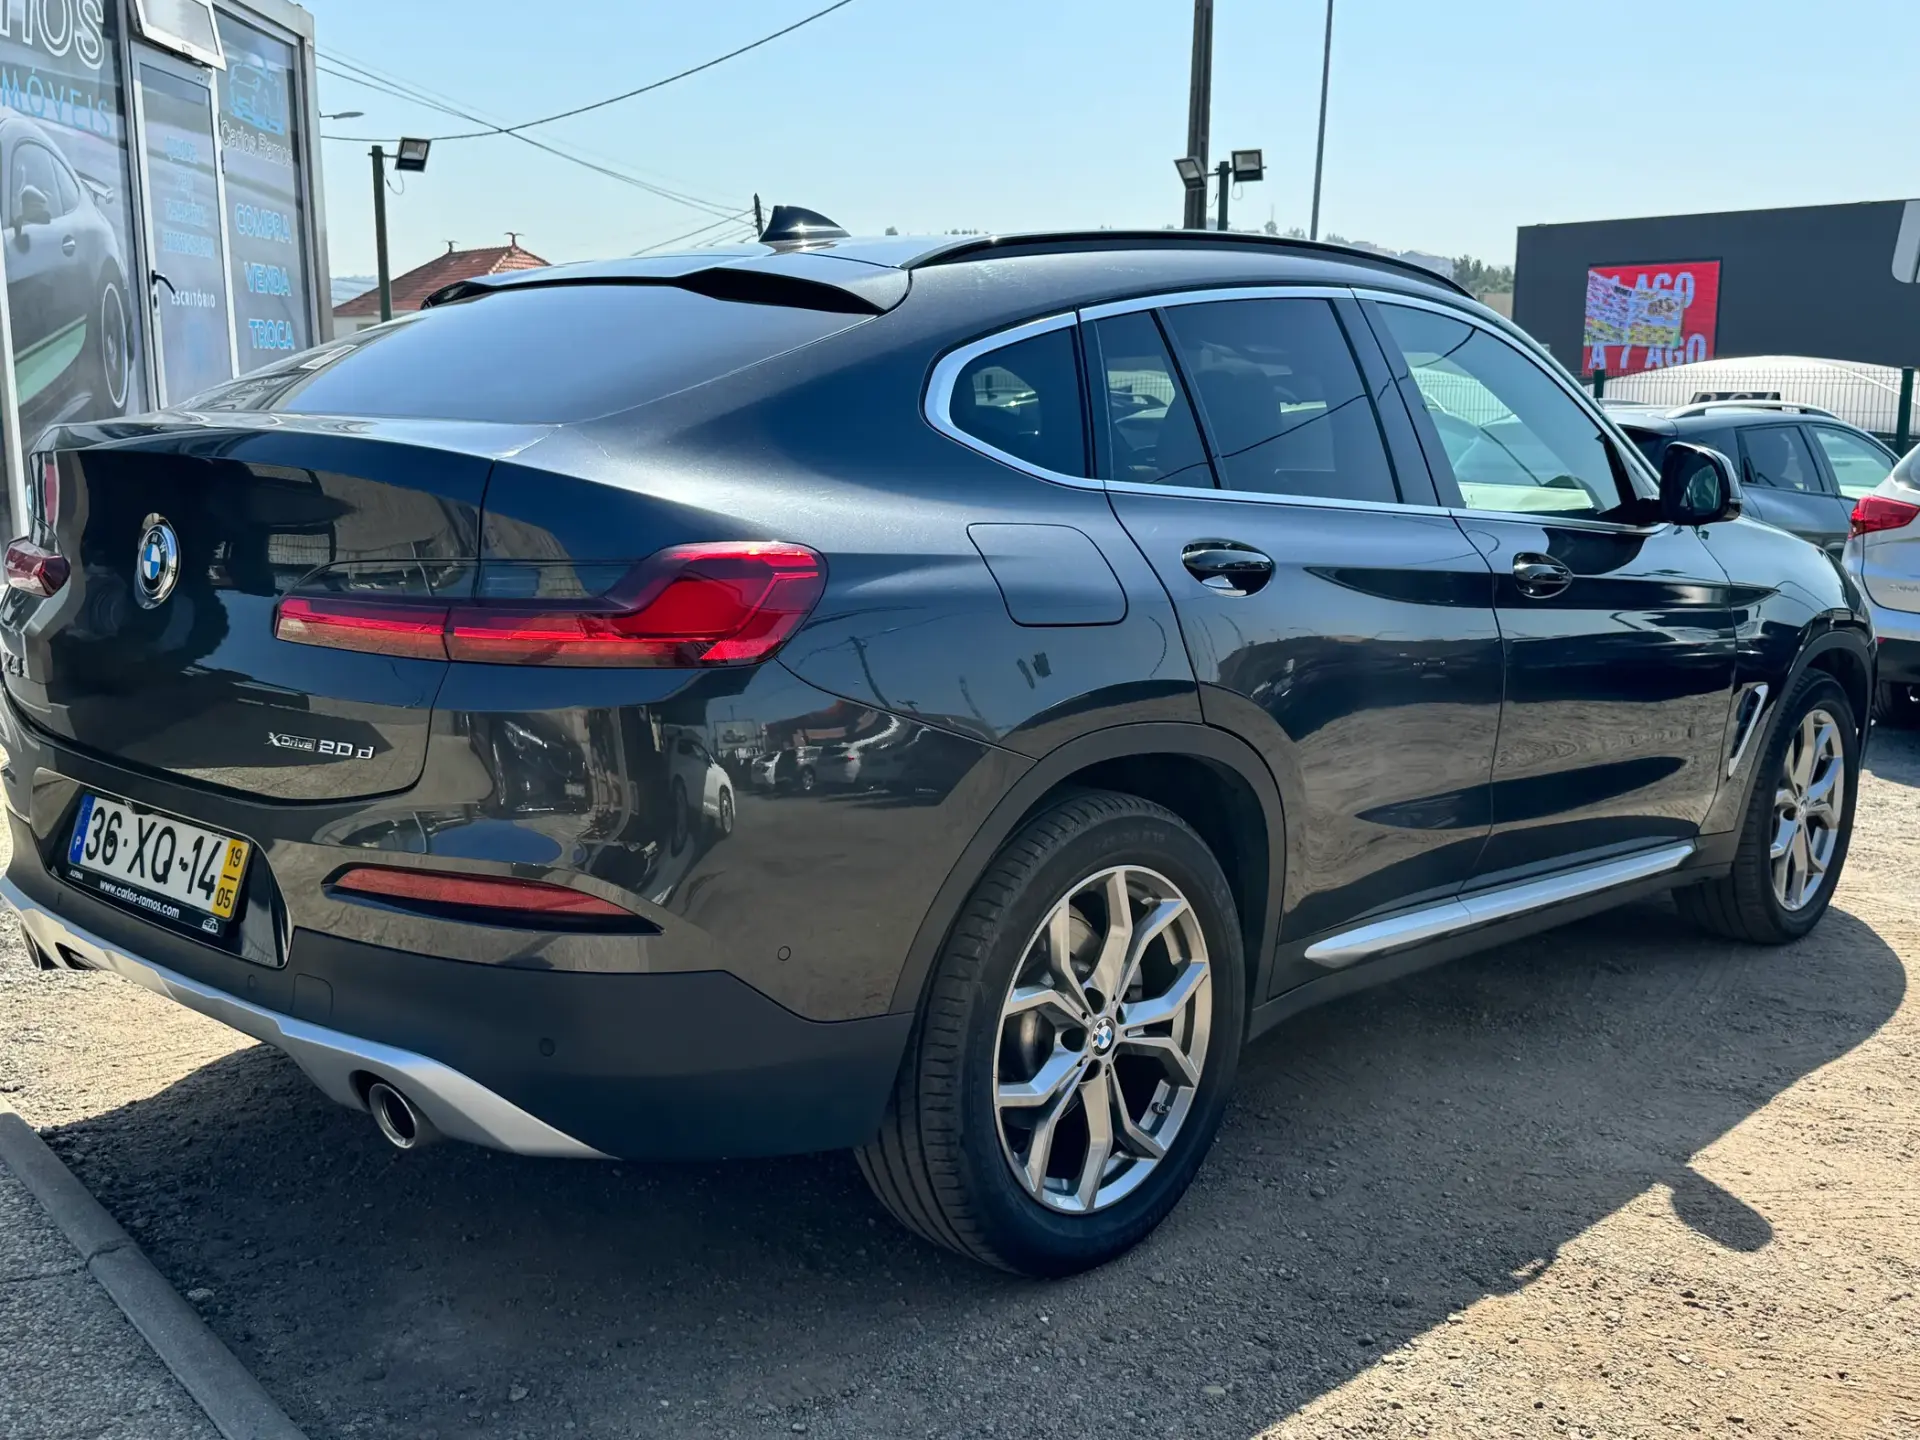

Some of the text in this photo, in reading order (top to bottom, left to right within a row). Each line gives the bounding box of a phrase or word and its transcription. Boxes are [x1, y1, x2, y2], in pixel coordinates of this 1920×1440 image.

[221, 119, 257, 157] Carlos
[257, 132, 293, 169] Ramos
[235, 202, 292, 244] COMPRA
[243, 261, 292, 297] VENDA
[171, 286, 216, 309] ESCRITÓRIO
[248, 318, 296, 350] TROCA
[1644, 333, 1707, 369] AGO
[74, 835, 82, 851] P
[230, 846, 244, 868] 19
[100, 879, 180, 919] www.carlos-ramos.com
[216, 887, 234, 909] 05
